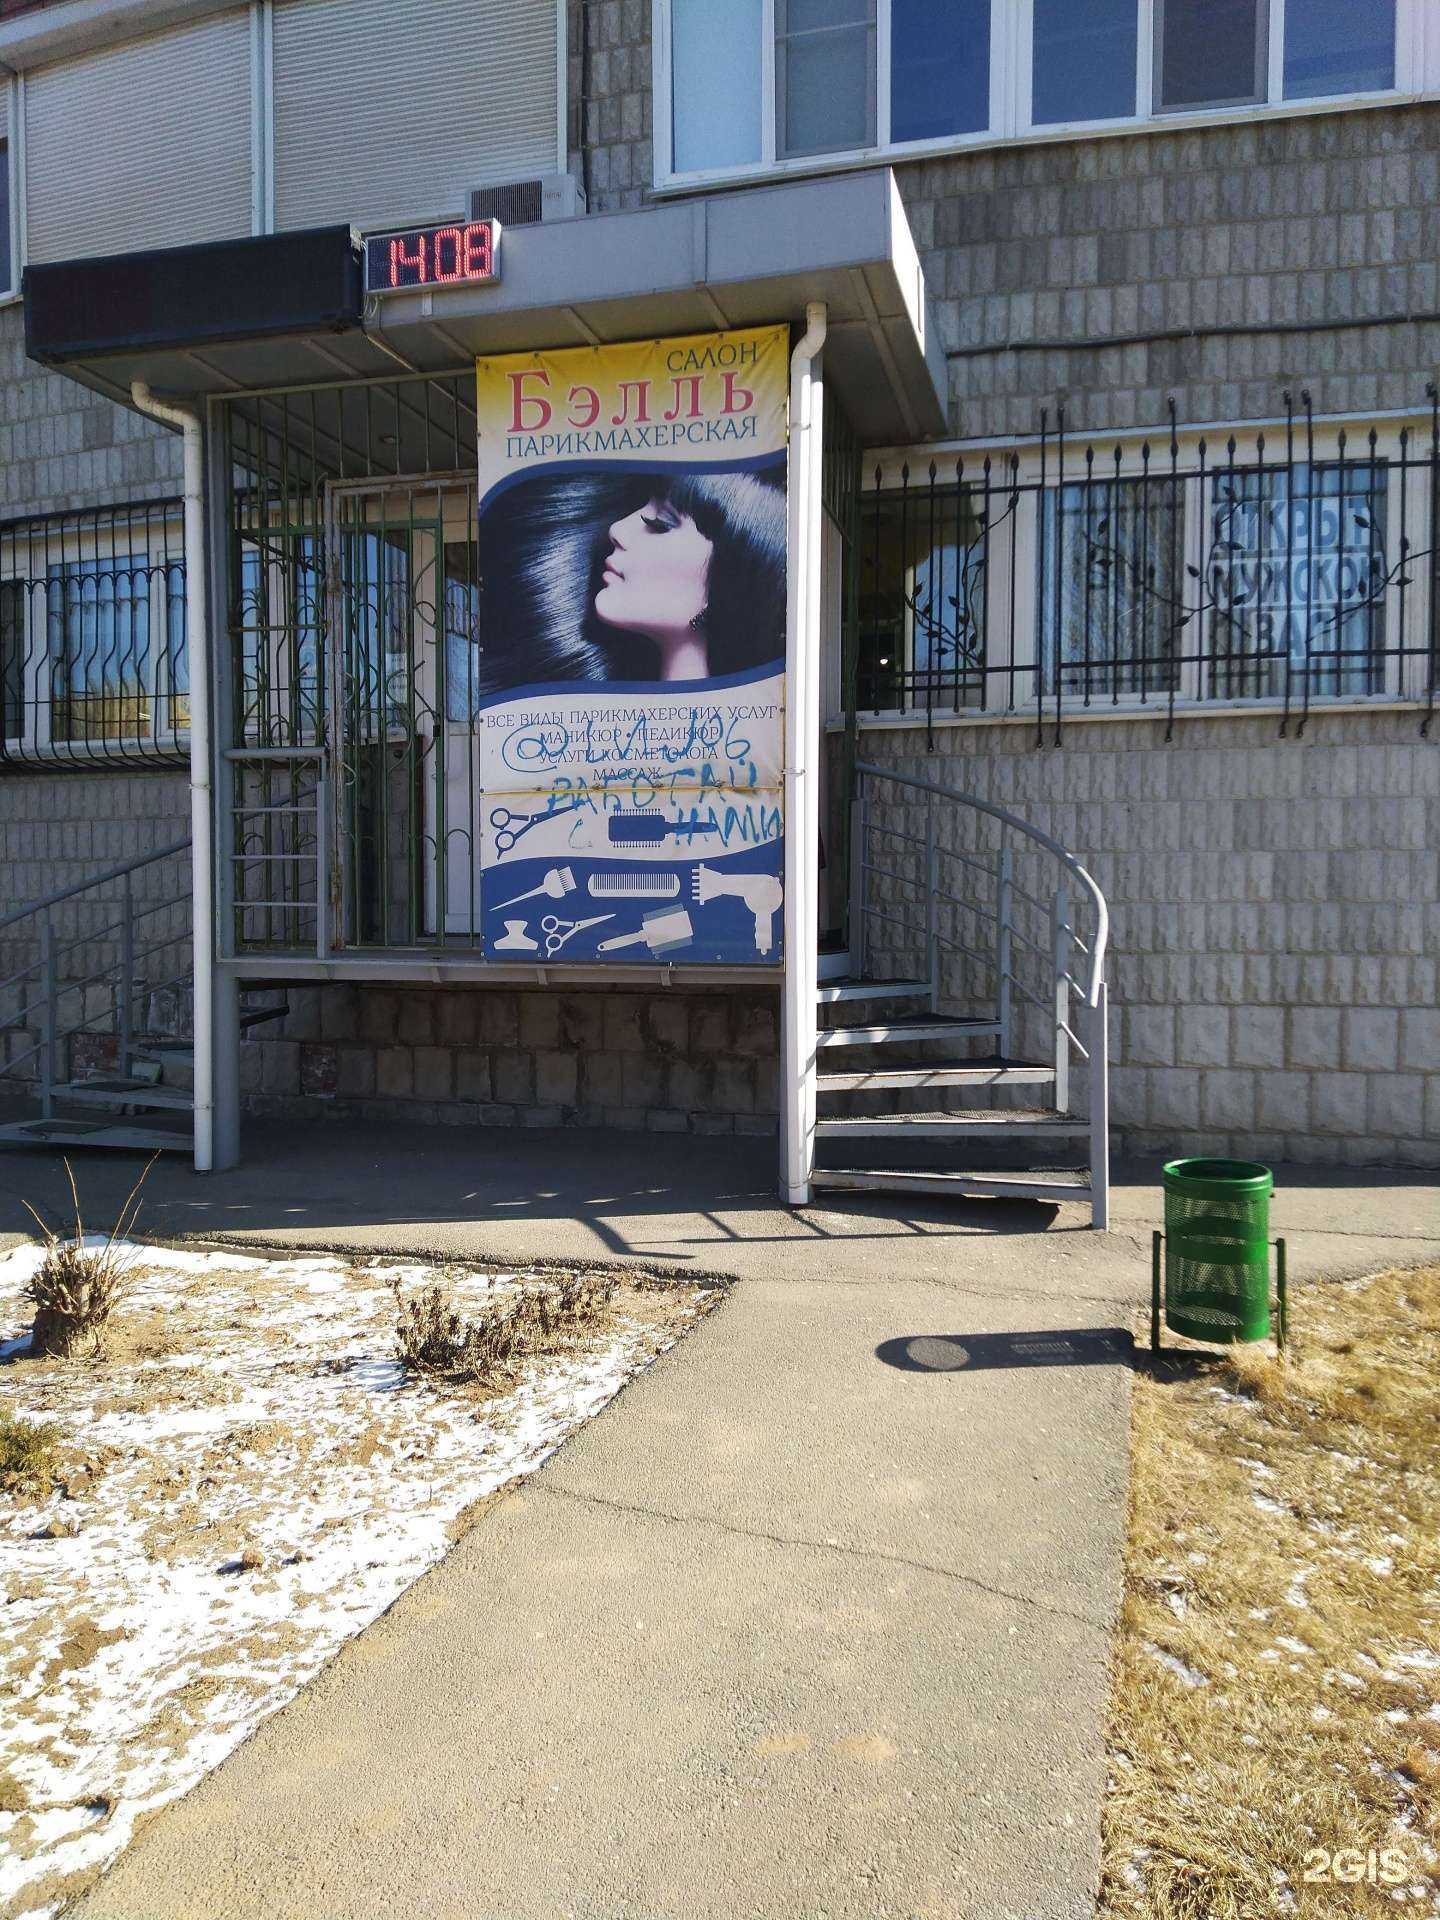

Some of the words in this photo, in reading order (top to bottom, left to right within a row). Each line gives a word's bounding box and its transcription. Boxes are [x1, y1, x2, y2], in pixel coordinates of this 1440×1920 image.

[666, 341, 758, 372] САЛОН
[506, 415, 758, 458] ПАРИКМАХЕРСКАЯ
[487, 714, 515, 728] ВСЕ
[520, 711, 564, 726] ВИДЫ
[570, 706, 721, 724] ПАРИКМАХЕРСКИХ
[727, 705, 778, 720] УСЛУГ
[540, 728, 622, 745] МАНИКЮР
[637, 726, 720, 741] ПЕДИКЮР
[539, 748, 595, 764] УСЛУГИ
[600, 746, 719, 762] КОСМЕТОЛОГА
[592, 766, 664, 781] МАССАЖ
